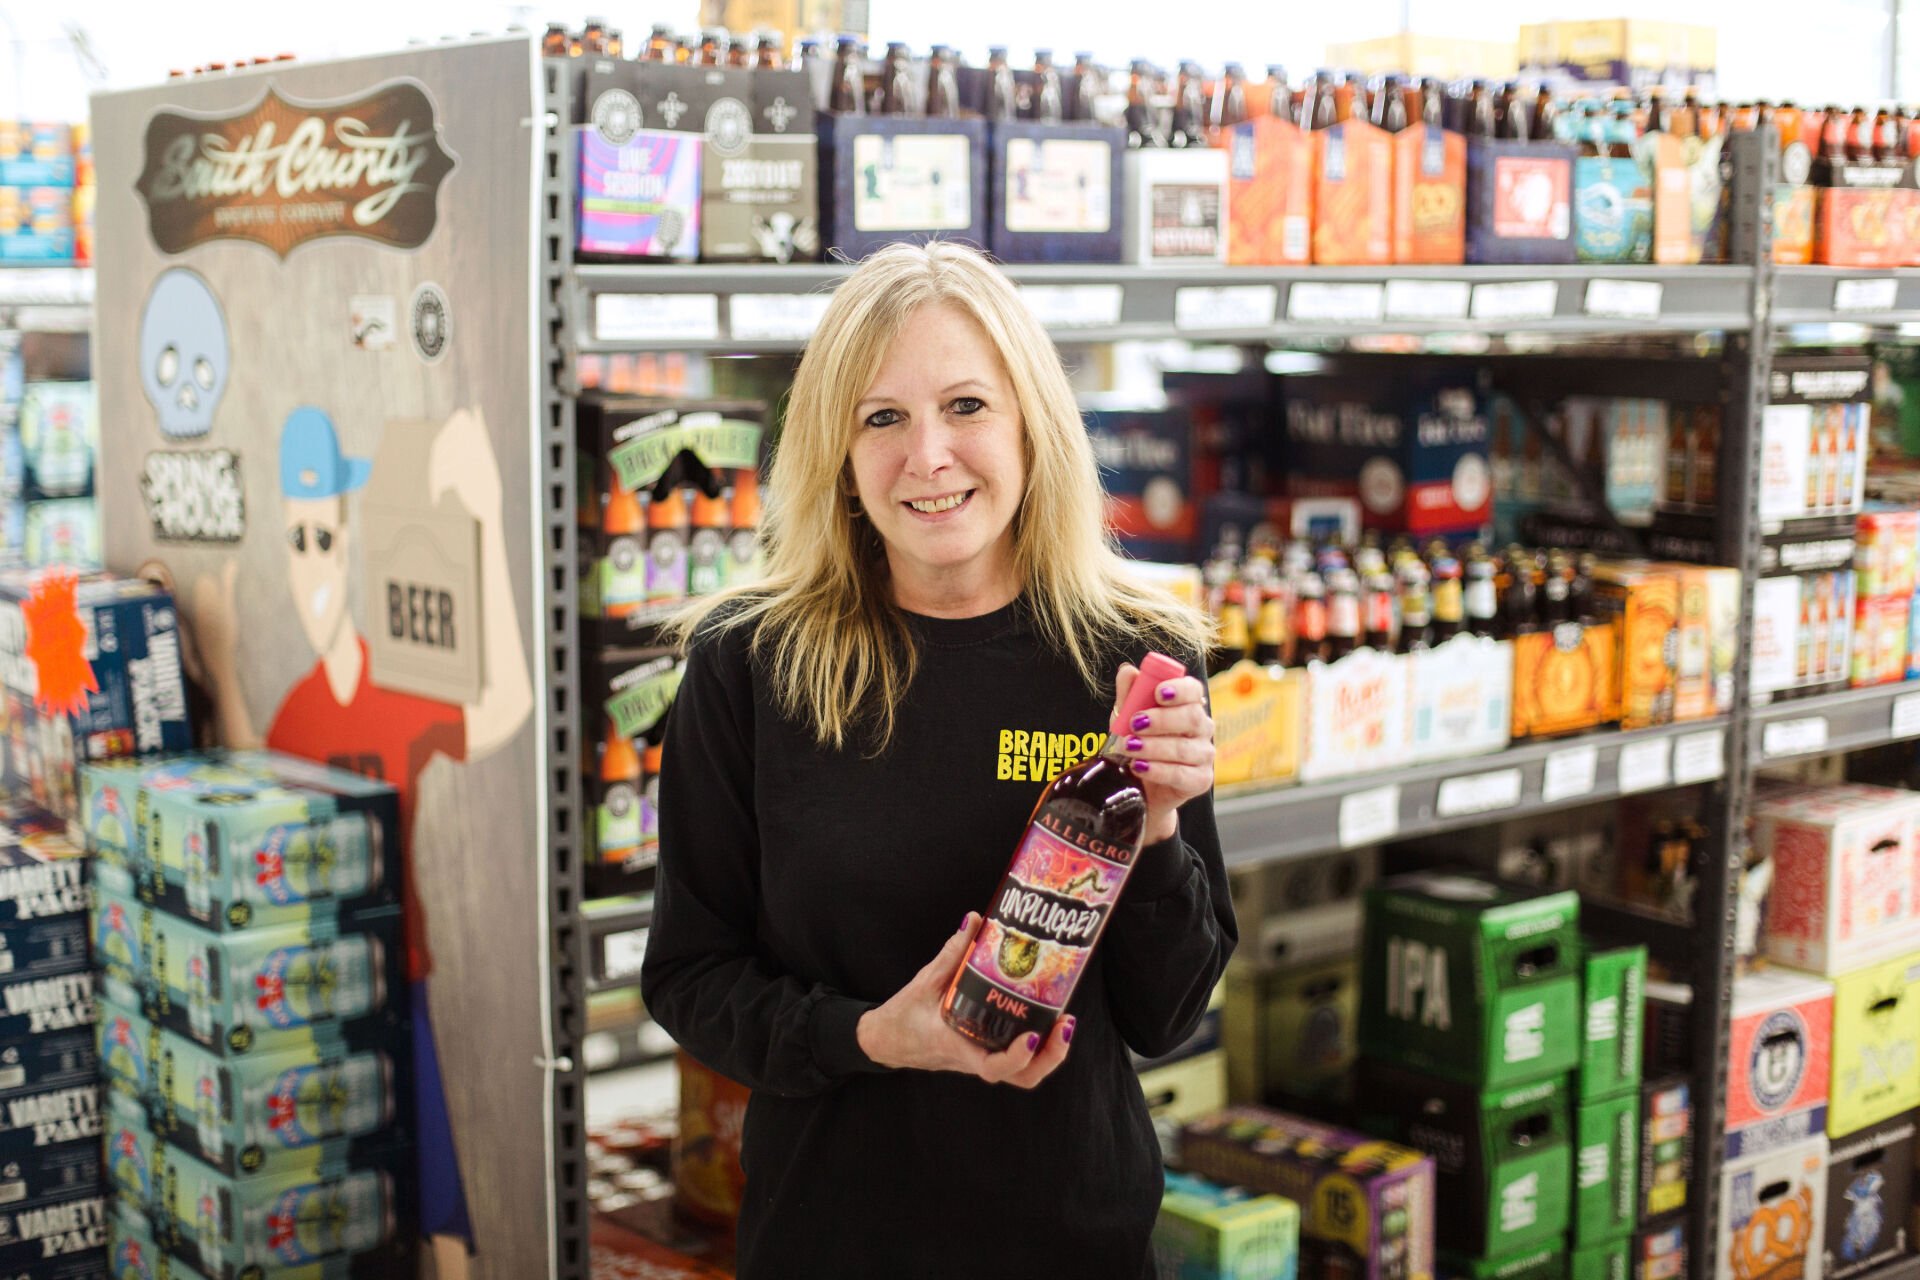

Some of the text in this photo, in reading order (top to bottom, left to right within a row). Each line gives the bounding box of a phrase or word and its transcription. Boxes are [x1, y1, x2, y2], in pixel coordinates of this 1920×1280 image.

[152, 116, 434, 225] South County
[388, 582, 455, 649] BEER
[997, 753, 1091, 782] BEVE
[1041, 813, 1130, 862] ALLEGRO
[16, 886, 93, 920] PAC
[999, 887, 1100, 939] UNPLUGGED
[4, 973, 94, 1016] VARIETY
[985, 988, 1030, 1019] PUNK
[1387, 936, 1452, 1031] IPA
[29, 1001, 97, 1033] PAC
[8, 1088, 98, 1129] VARIETY
[34, 1116, 104, 1146] PAC
[16, 1198, 105, 1240] VARIETY
[42, 1225, 107, 1258] PAC
